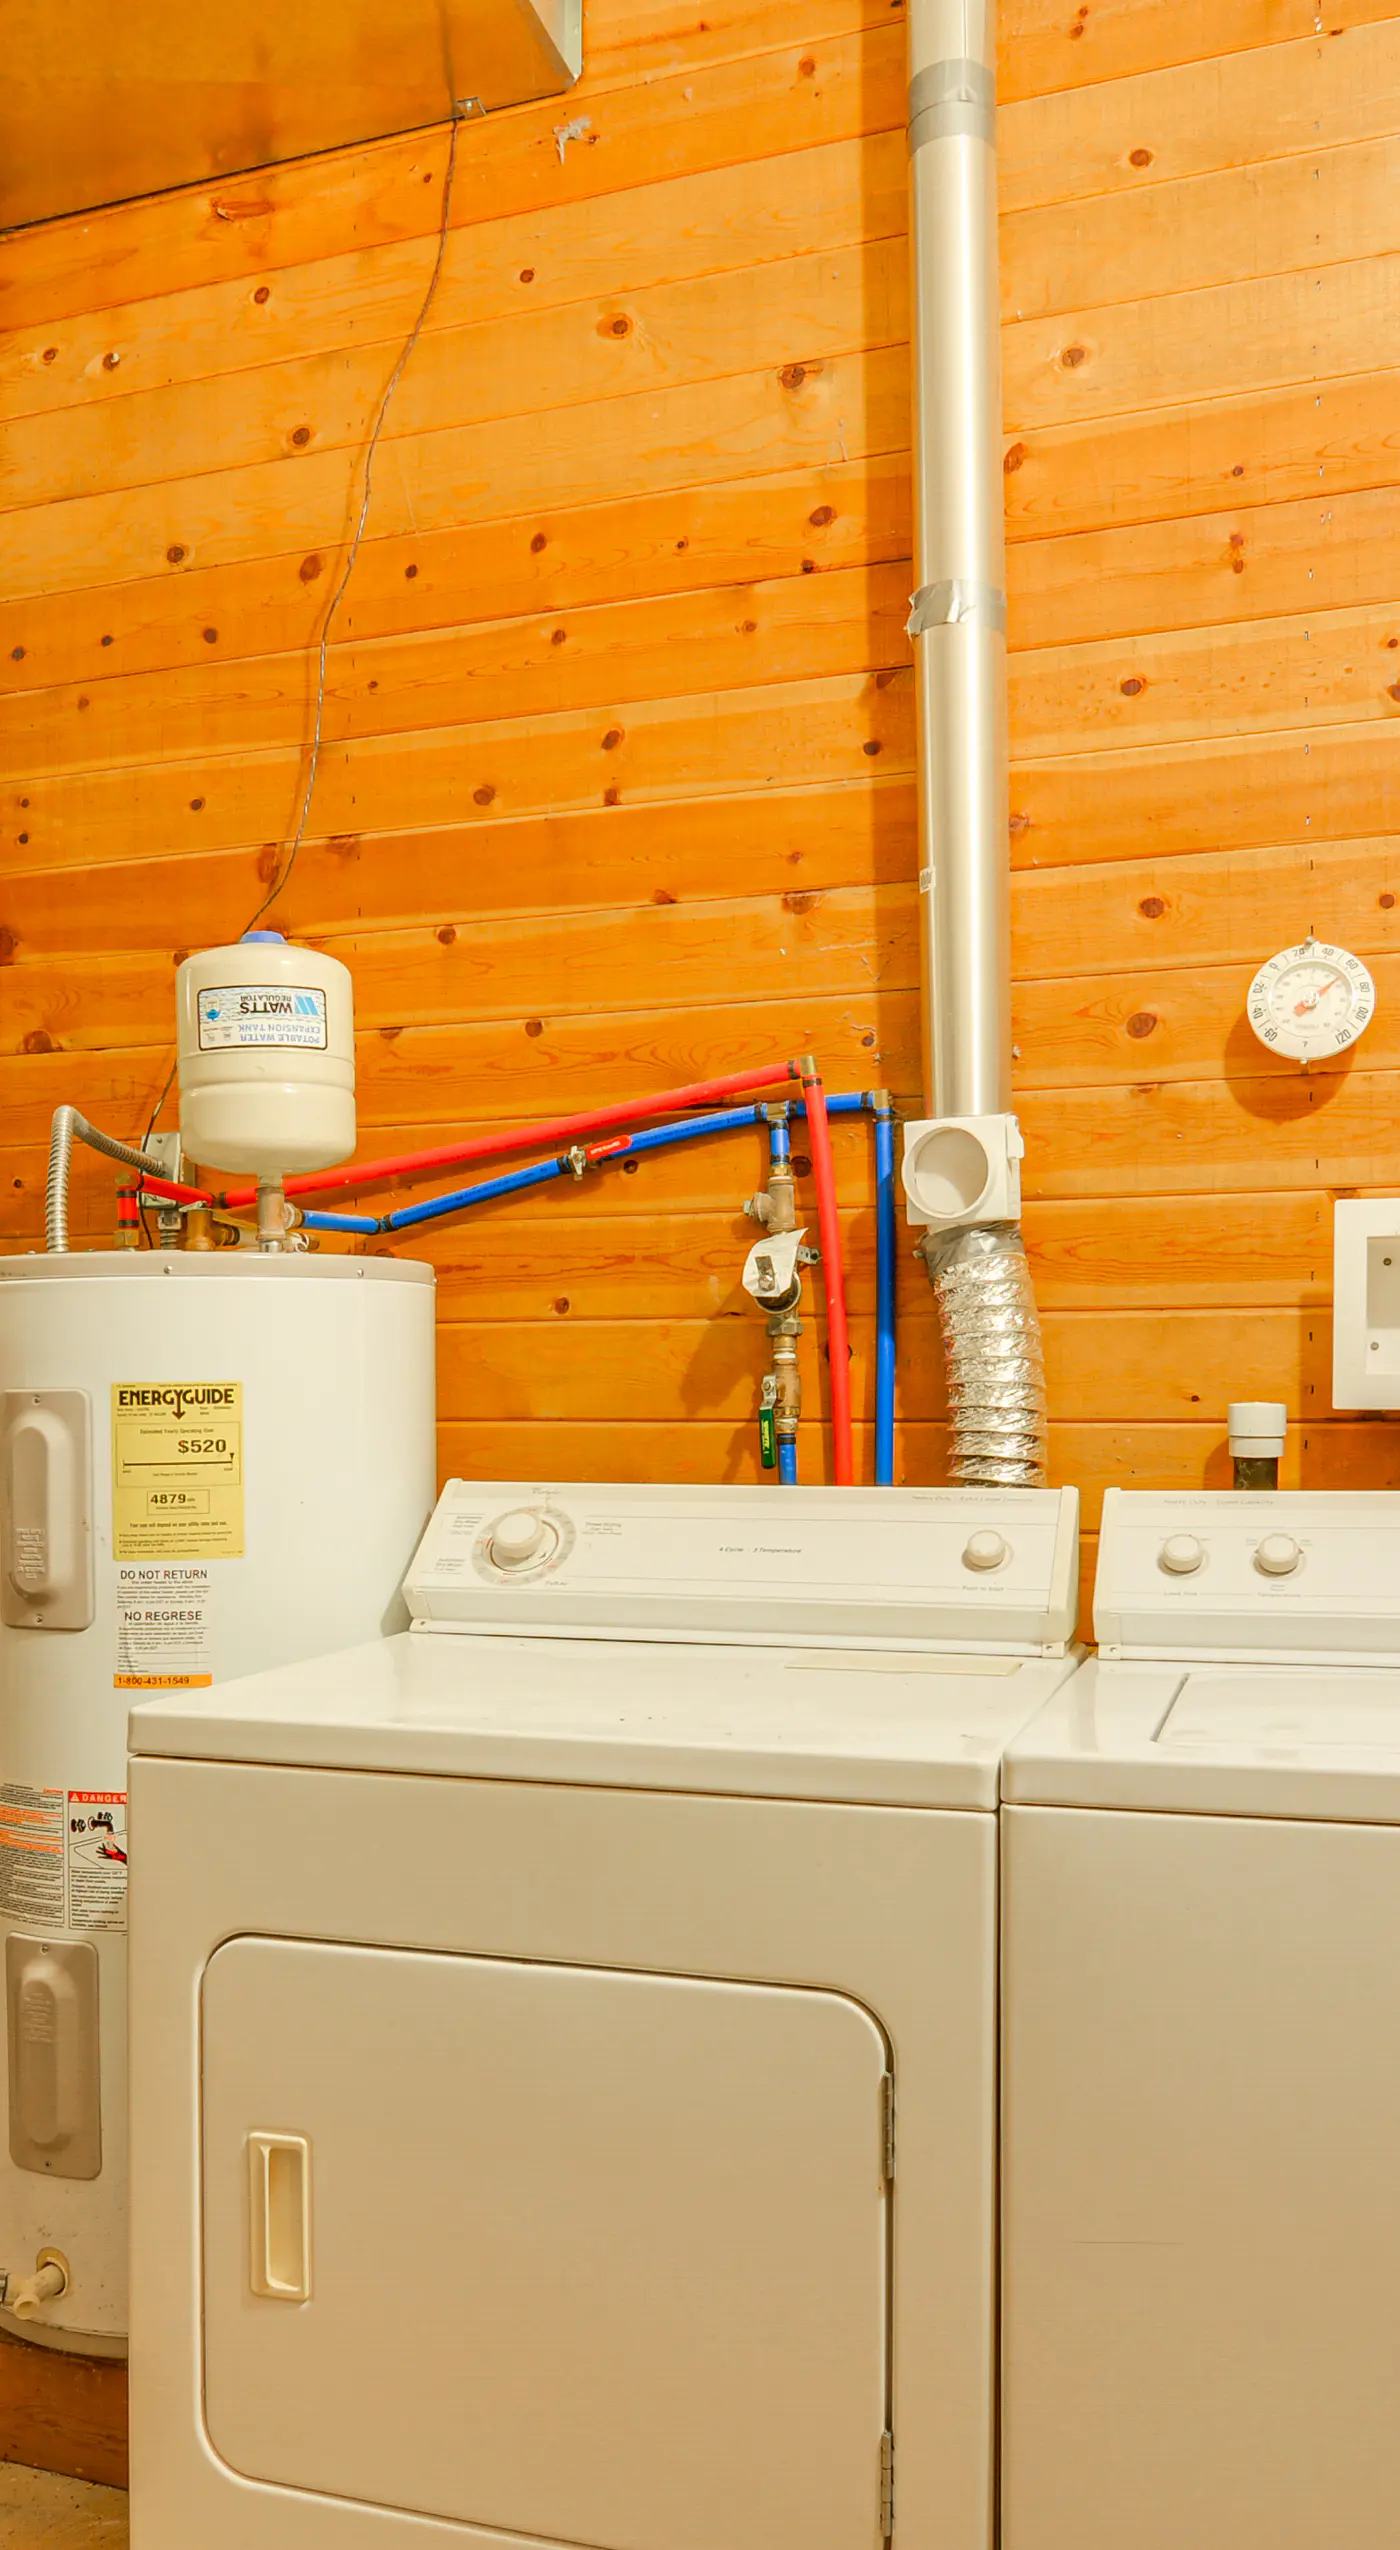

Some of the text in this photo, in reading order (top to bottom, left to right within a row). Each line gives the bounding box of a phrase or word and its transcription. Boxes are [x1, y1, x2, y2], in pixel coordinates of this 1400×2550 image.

[1322, 947, 1335, 956] 40
[240, 1001, 293, 1014] WATTS
[238, 1023, 320, 1034] EXPANSION TANK
[240, 1033, 275, 1042] WATER
[278, 1034, 320, 1043] POTABLE
[1335, 1029, 1351, 1044] 120
[118, 1388, 234, 1406] ENERGYGUIDE
[178, 1439, 227, 1455] $520
[150, 1493, 186, 1504] 4879
[120, 1569, 208, 1580] DO NOT RETURN
[124, 1611, 203, 1621] NO REGRESE
[118, 1676, 190, 1685] 1-800-431-1549
[81, 1793, 127, 1803] DANGER
